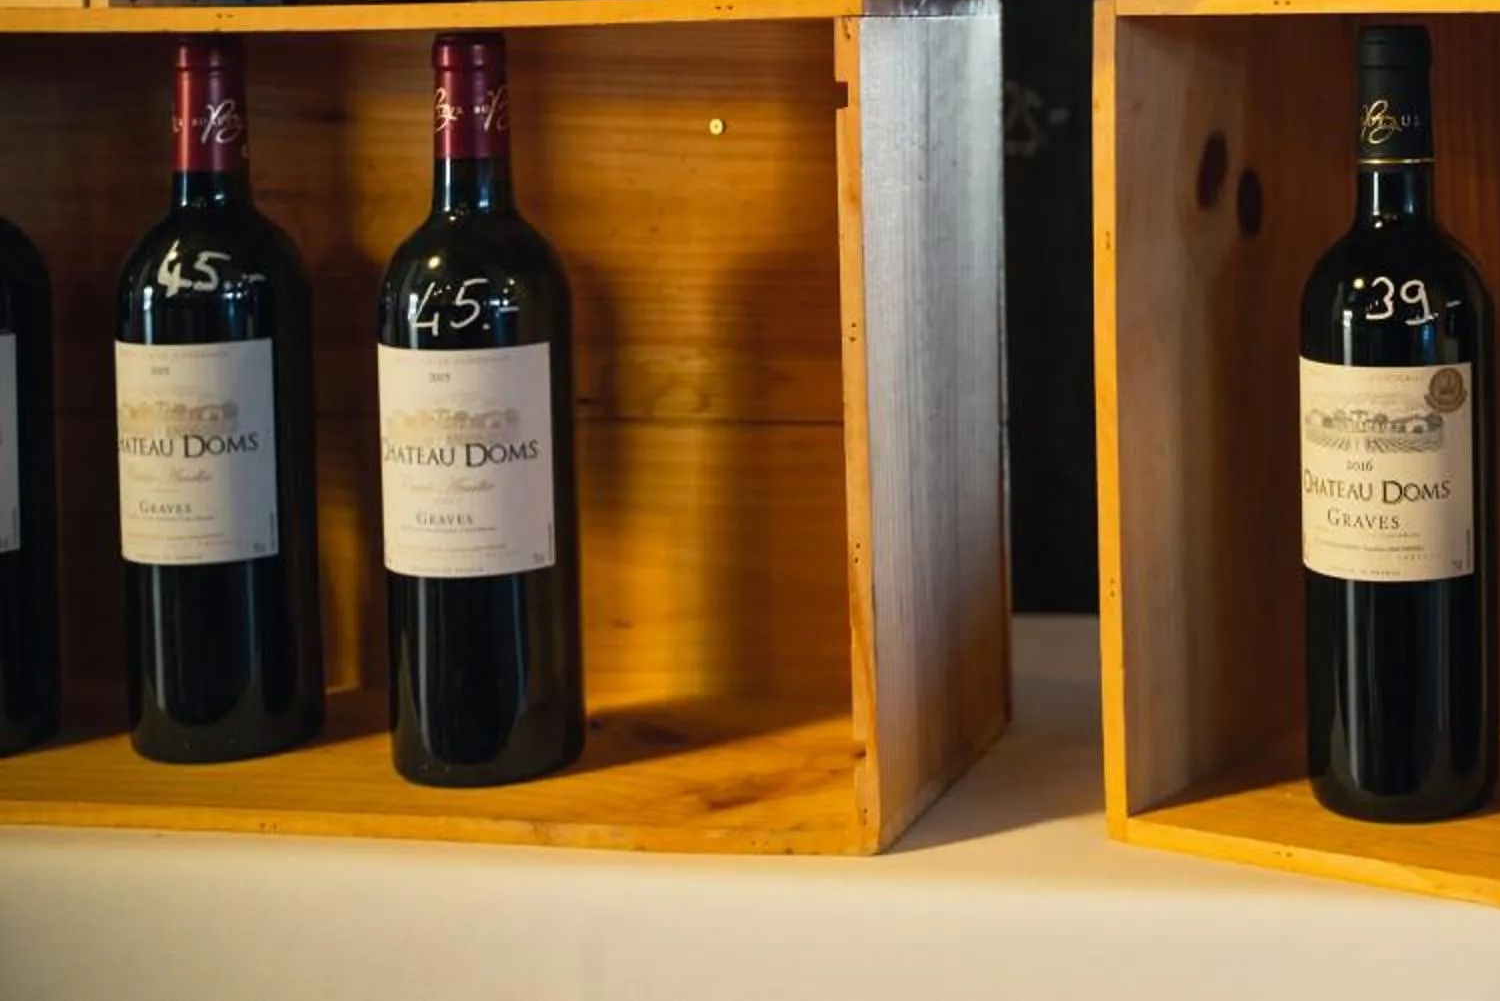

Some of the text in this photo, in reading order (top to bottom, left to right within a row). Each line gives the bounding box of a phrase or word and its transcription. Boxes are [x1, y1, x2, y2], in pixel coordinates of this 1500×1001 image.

[183, 432, 260, 459] DOMS
[465, 439, 540, 468] DOMS
[1346, 459, 1374, 471] 2016
[1382, 479, 1451, 505] DOMS
[415, 512, 474, 526] GRAVES
[1326, 507, 1401, 531] GRAVES
